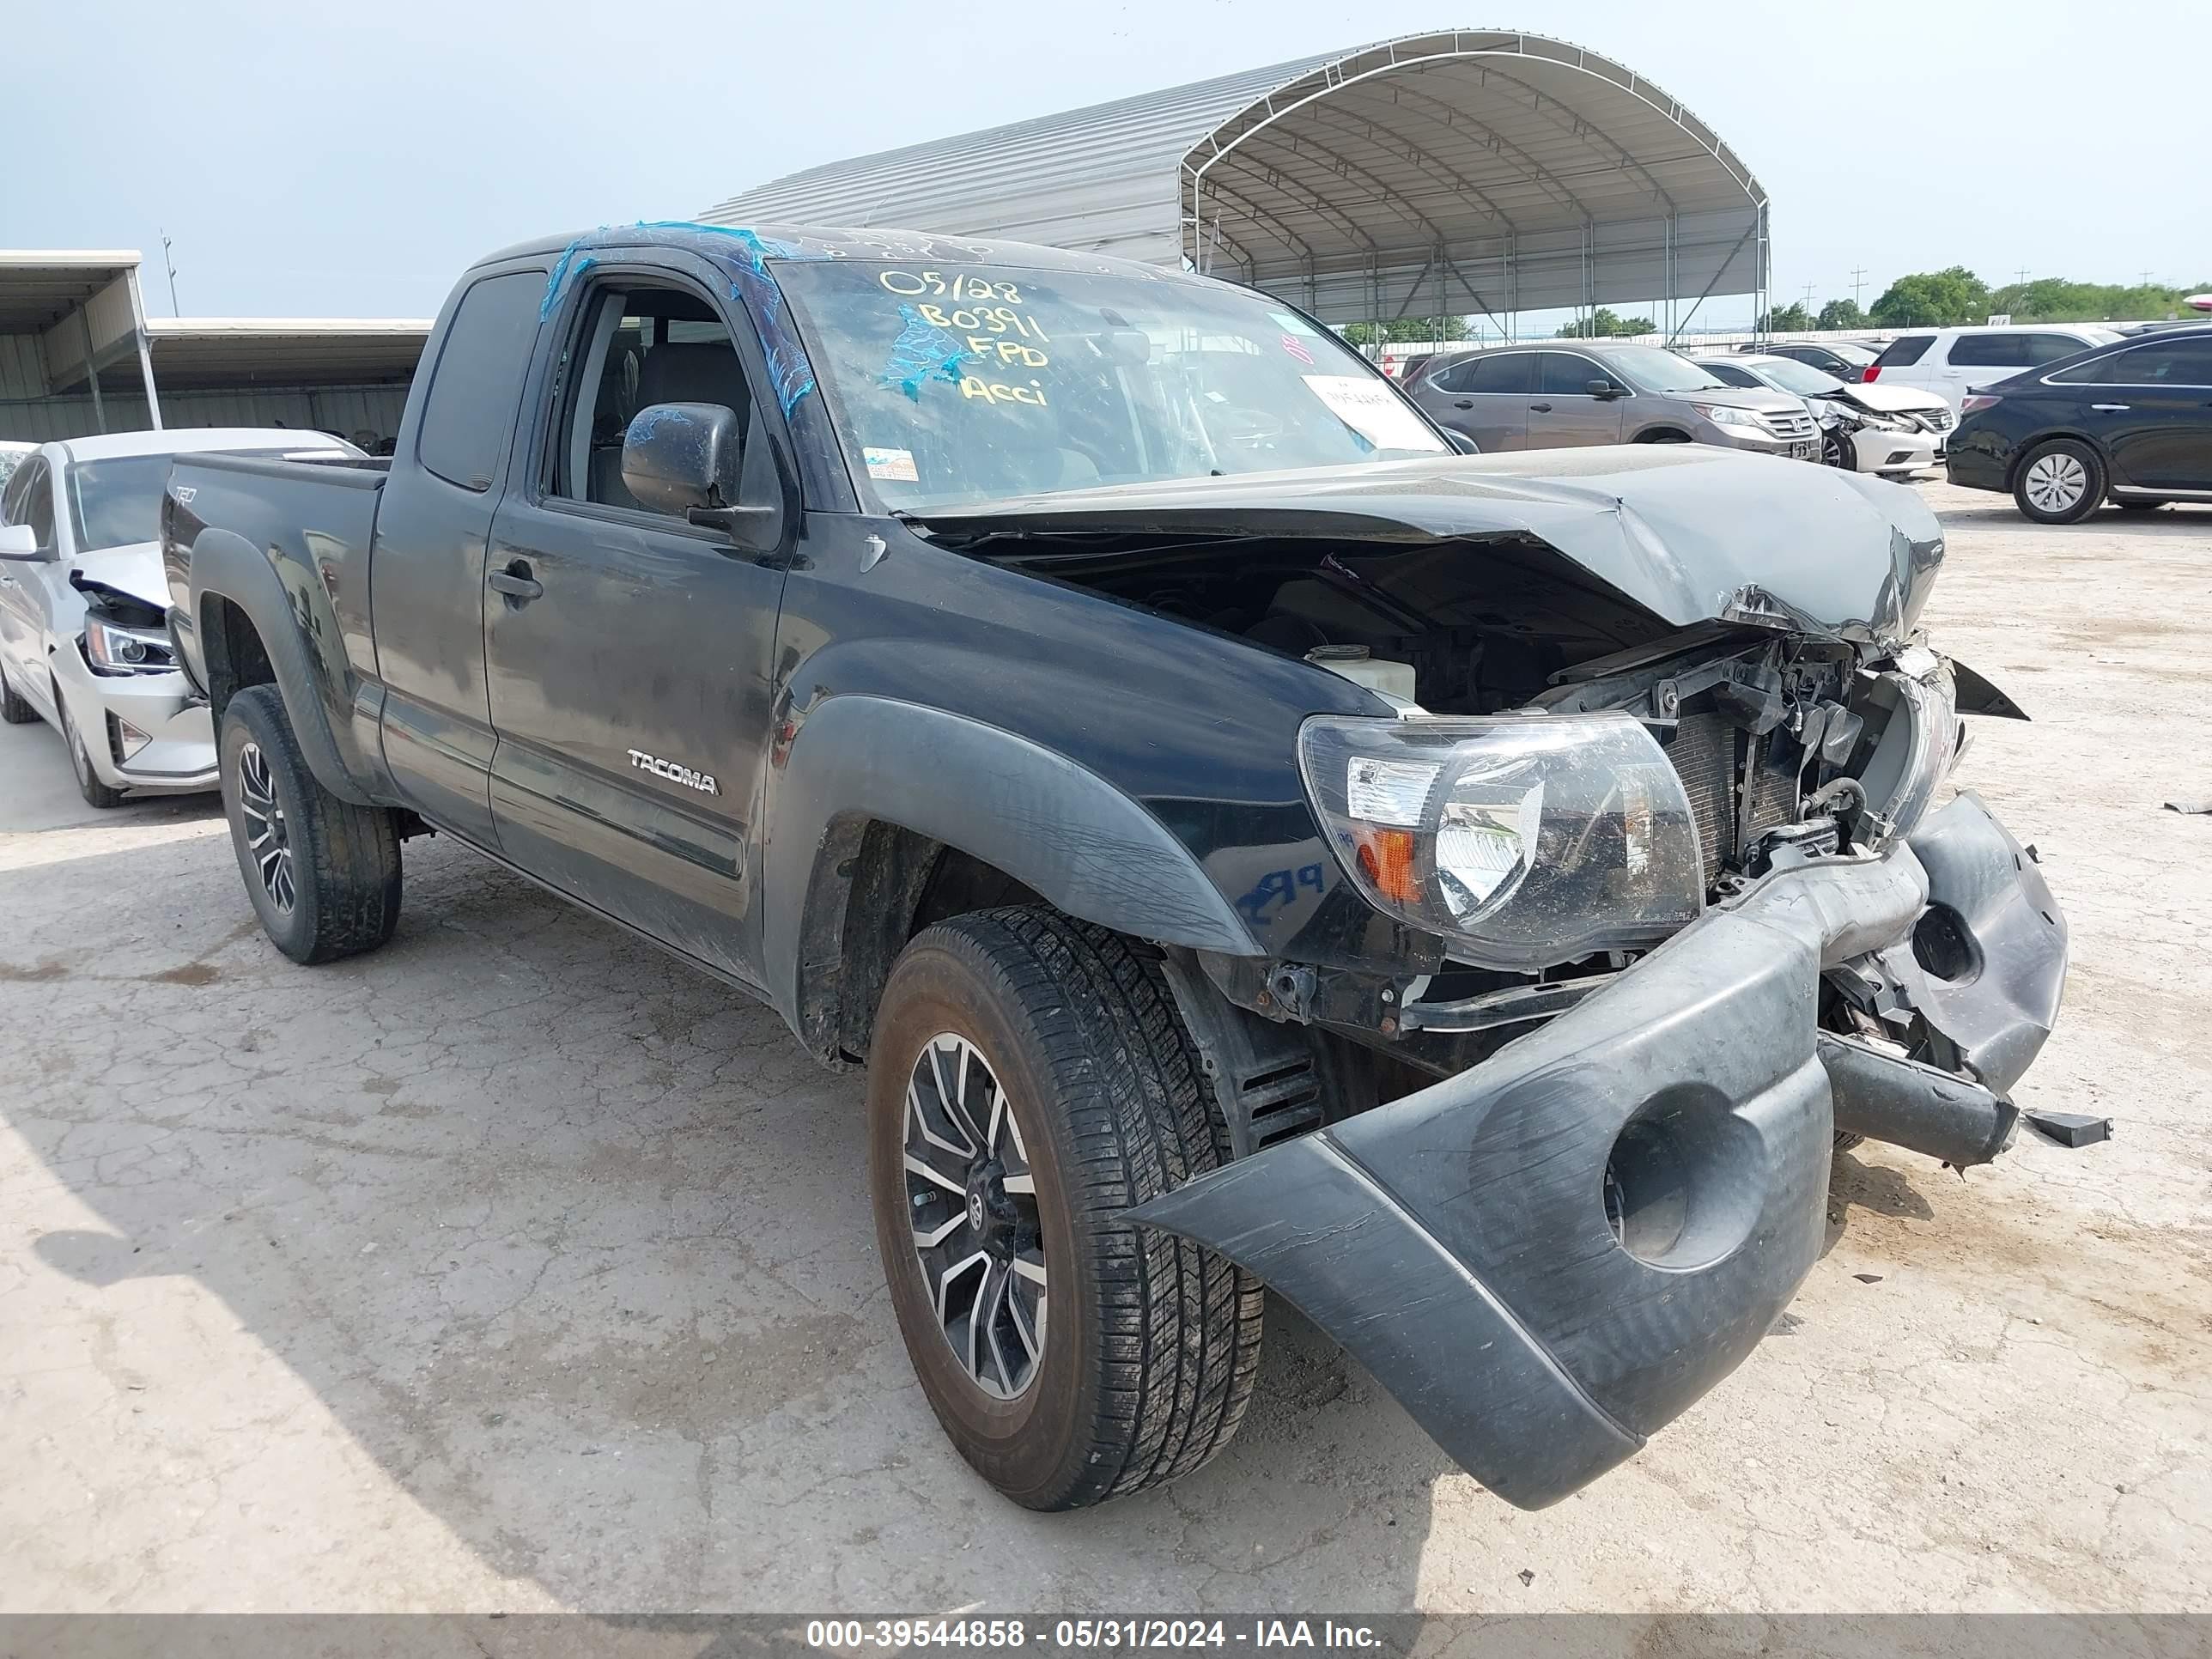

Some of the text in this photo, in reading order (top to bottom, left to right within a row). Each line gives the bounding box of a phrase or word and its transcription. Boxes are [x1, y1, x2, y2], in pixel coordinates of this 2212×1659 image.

[879, 270, 1023, 304] 05/28
[918, 304, 1050, 343] B0391
[176, 486, 198, 508] TRD
[627, 749, 721, 796] TACOMA
